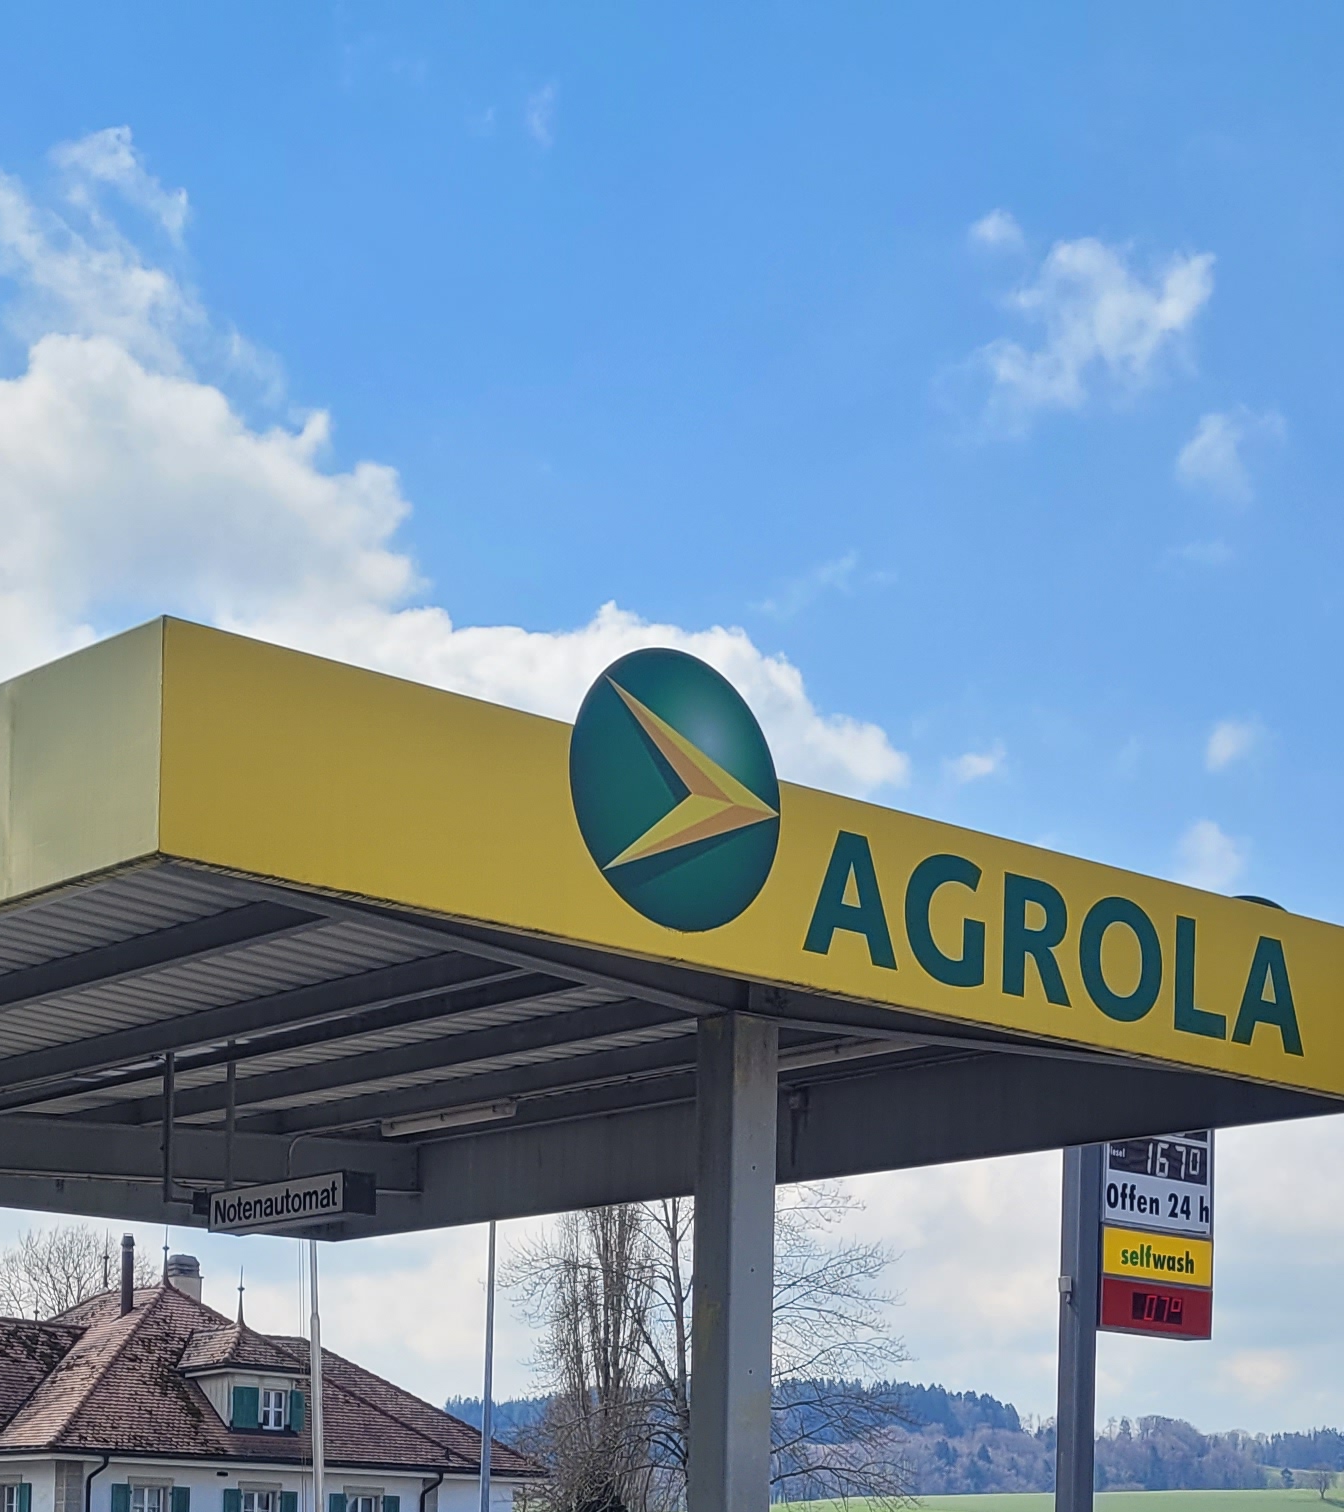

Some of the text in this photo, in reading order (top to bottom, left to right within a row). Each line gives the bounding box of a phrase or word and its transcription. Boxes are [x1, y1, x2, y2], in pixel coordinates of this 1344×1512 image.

[802, 829, 1305, 1057] AGROLA
[1110, 1145, 1126, 1158] iesel
[214, 1180, 338, 1225] Notenautomat
[1106, 1182, 1210, 1224] Offen 24 h
[1120, 1243, 1195, 1275] selfwash
